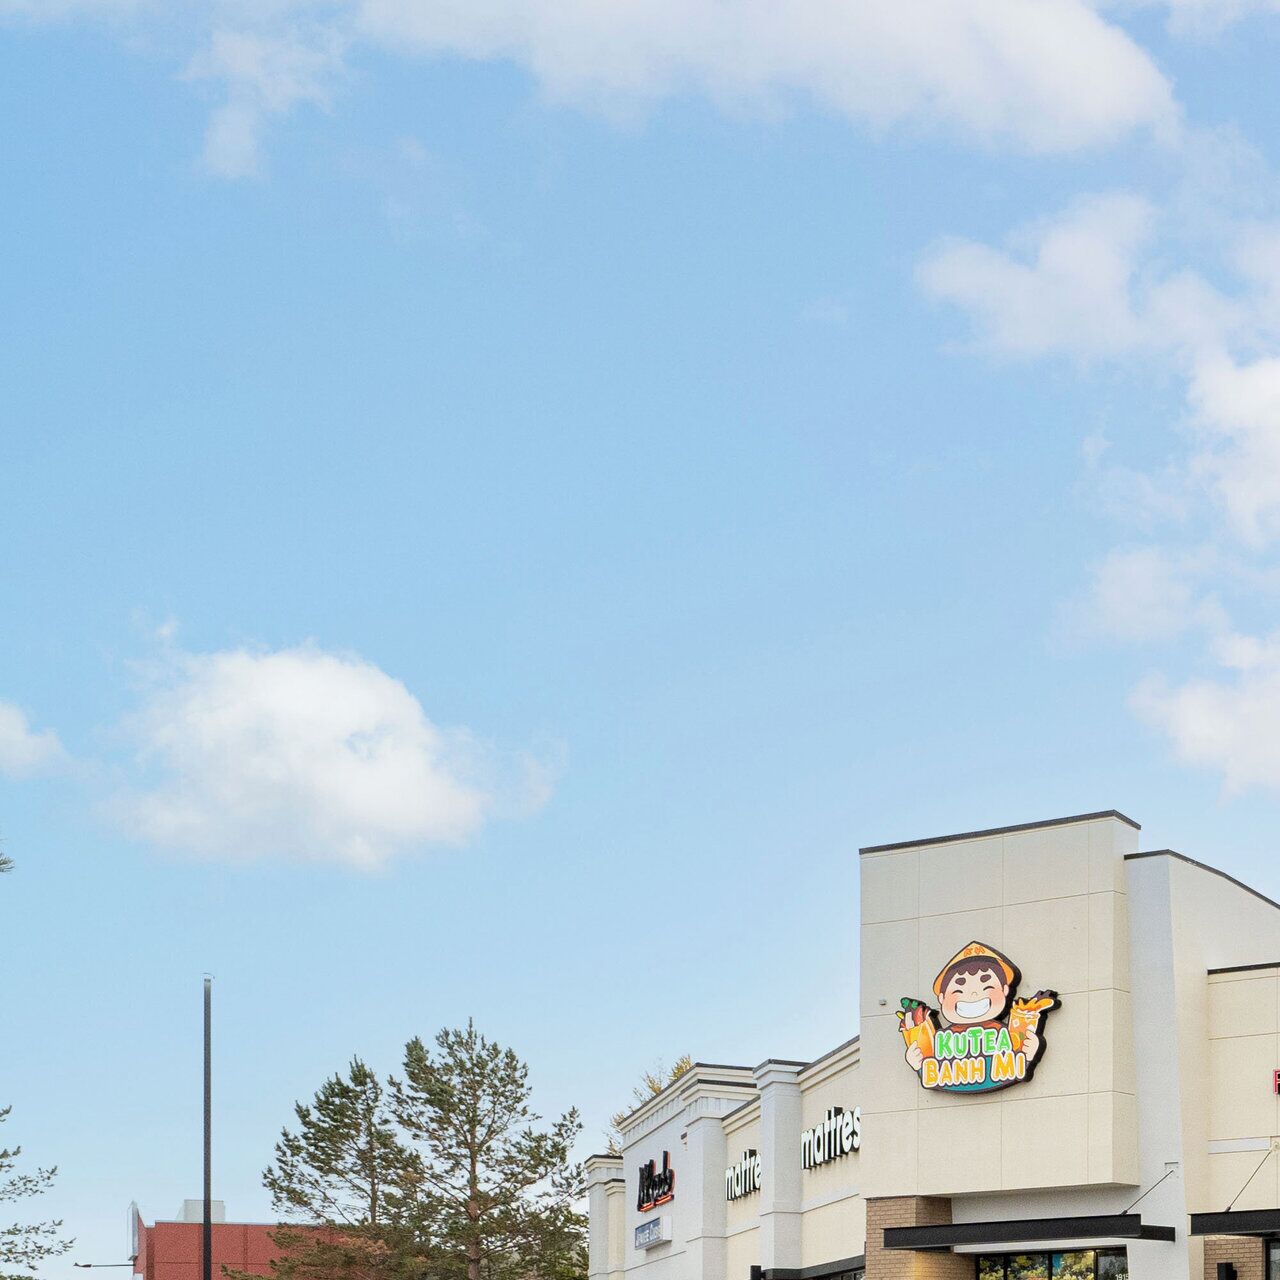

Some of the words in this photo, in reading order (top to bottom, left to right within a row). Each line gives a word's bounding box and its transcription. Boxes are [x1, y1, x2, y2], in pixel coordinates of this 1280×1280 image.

[935, 1026, 1013, 1060] KUTEA
[922, 1057, 985, 1088] BANH
[990, 1051, 1026, 1082] MI
